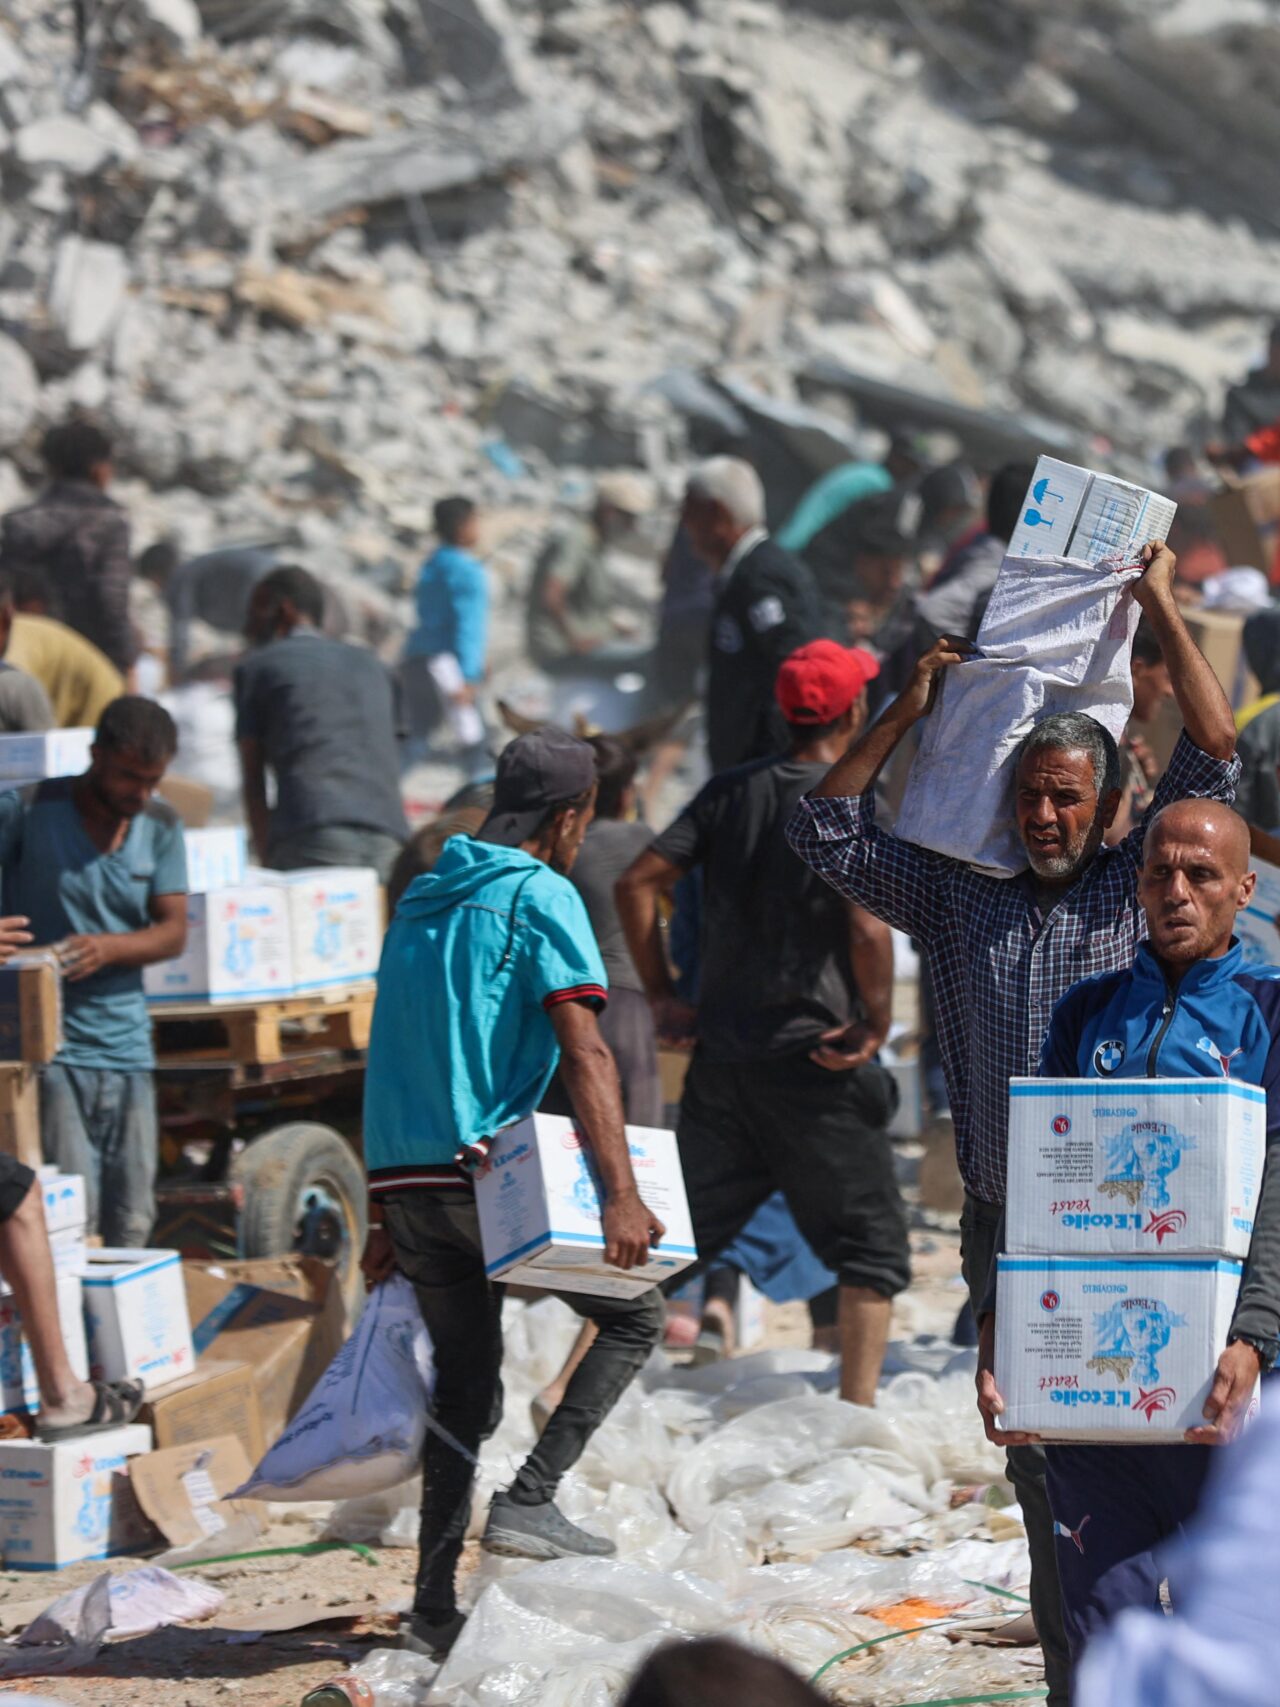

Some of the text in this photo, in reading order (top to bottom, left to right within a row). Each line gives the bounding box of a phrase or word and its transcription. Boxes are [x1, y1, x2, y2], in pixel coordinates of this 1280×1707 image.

[1049, 1199, 1091, 1216] Yeast
[1062, 1214, 1142, 1232] L'Etoile
[1038, 1374, 1080, 1391] Yeast
[1050, 1390, 1131, 1408] L'Etoile
